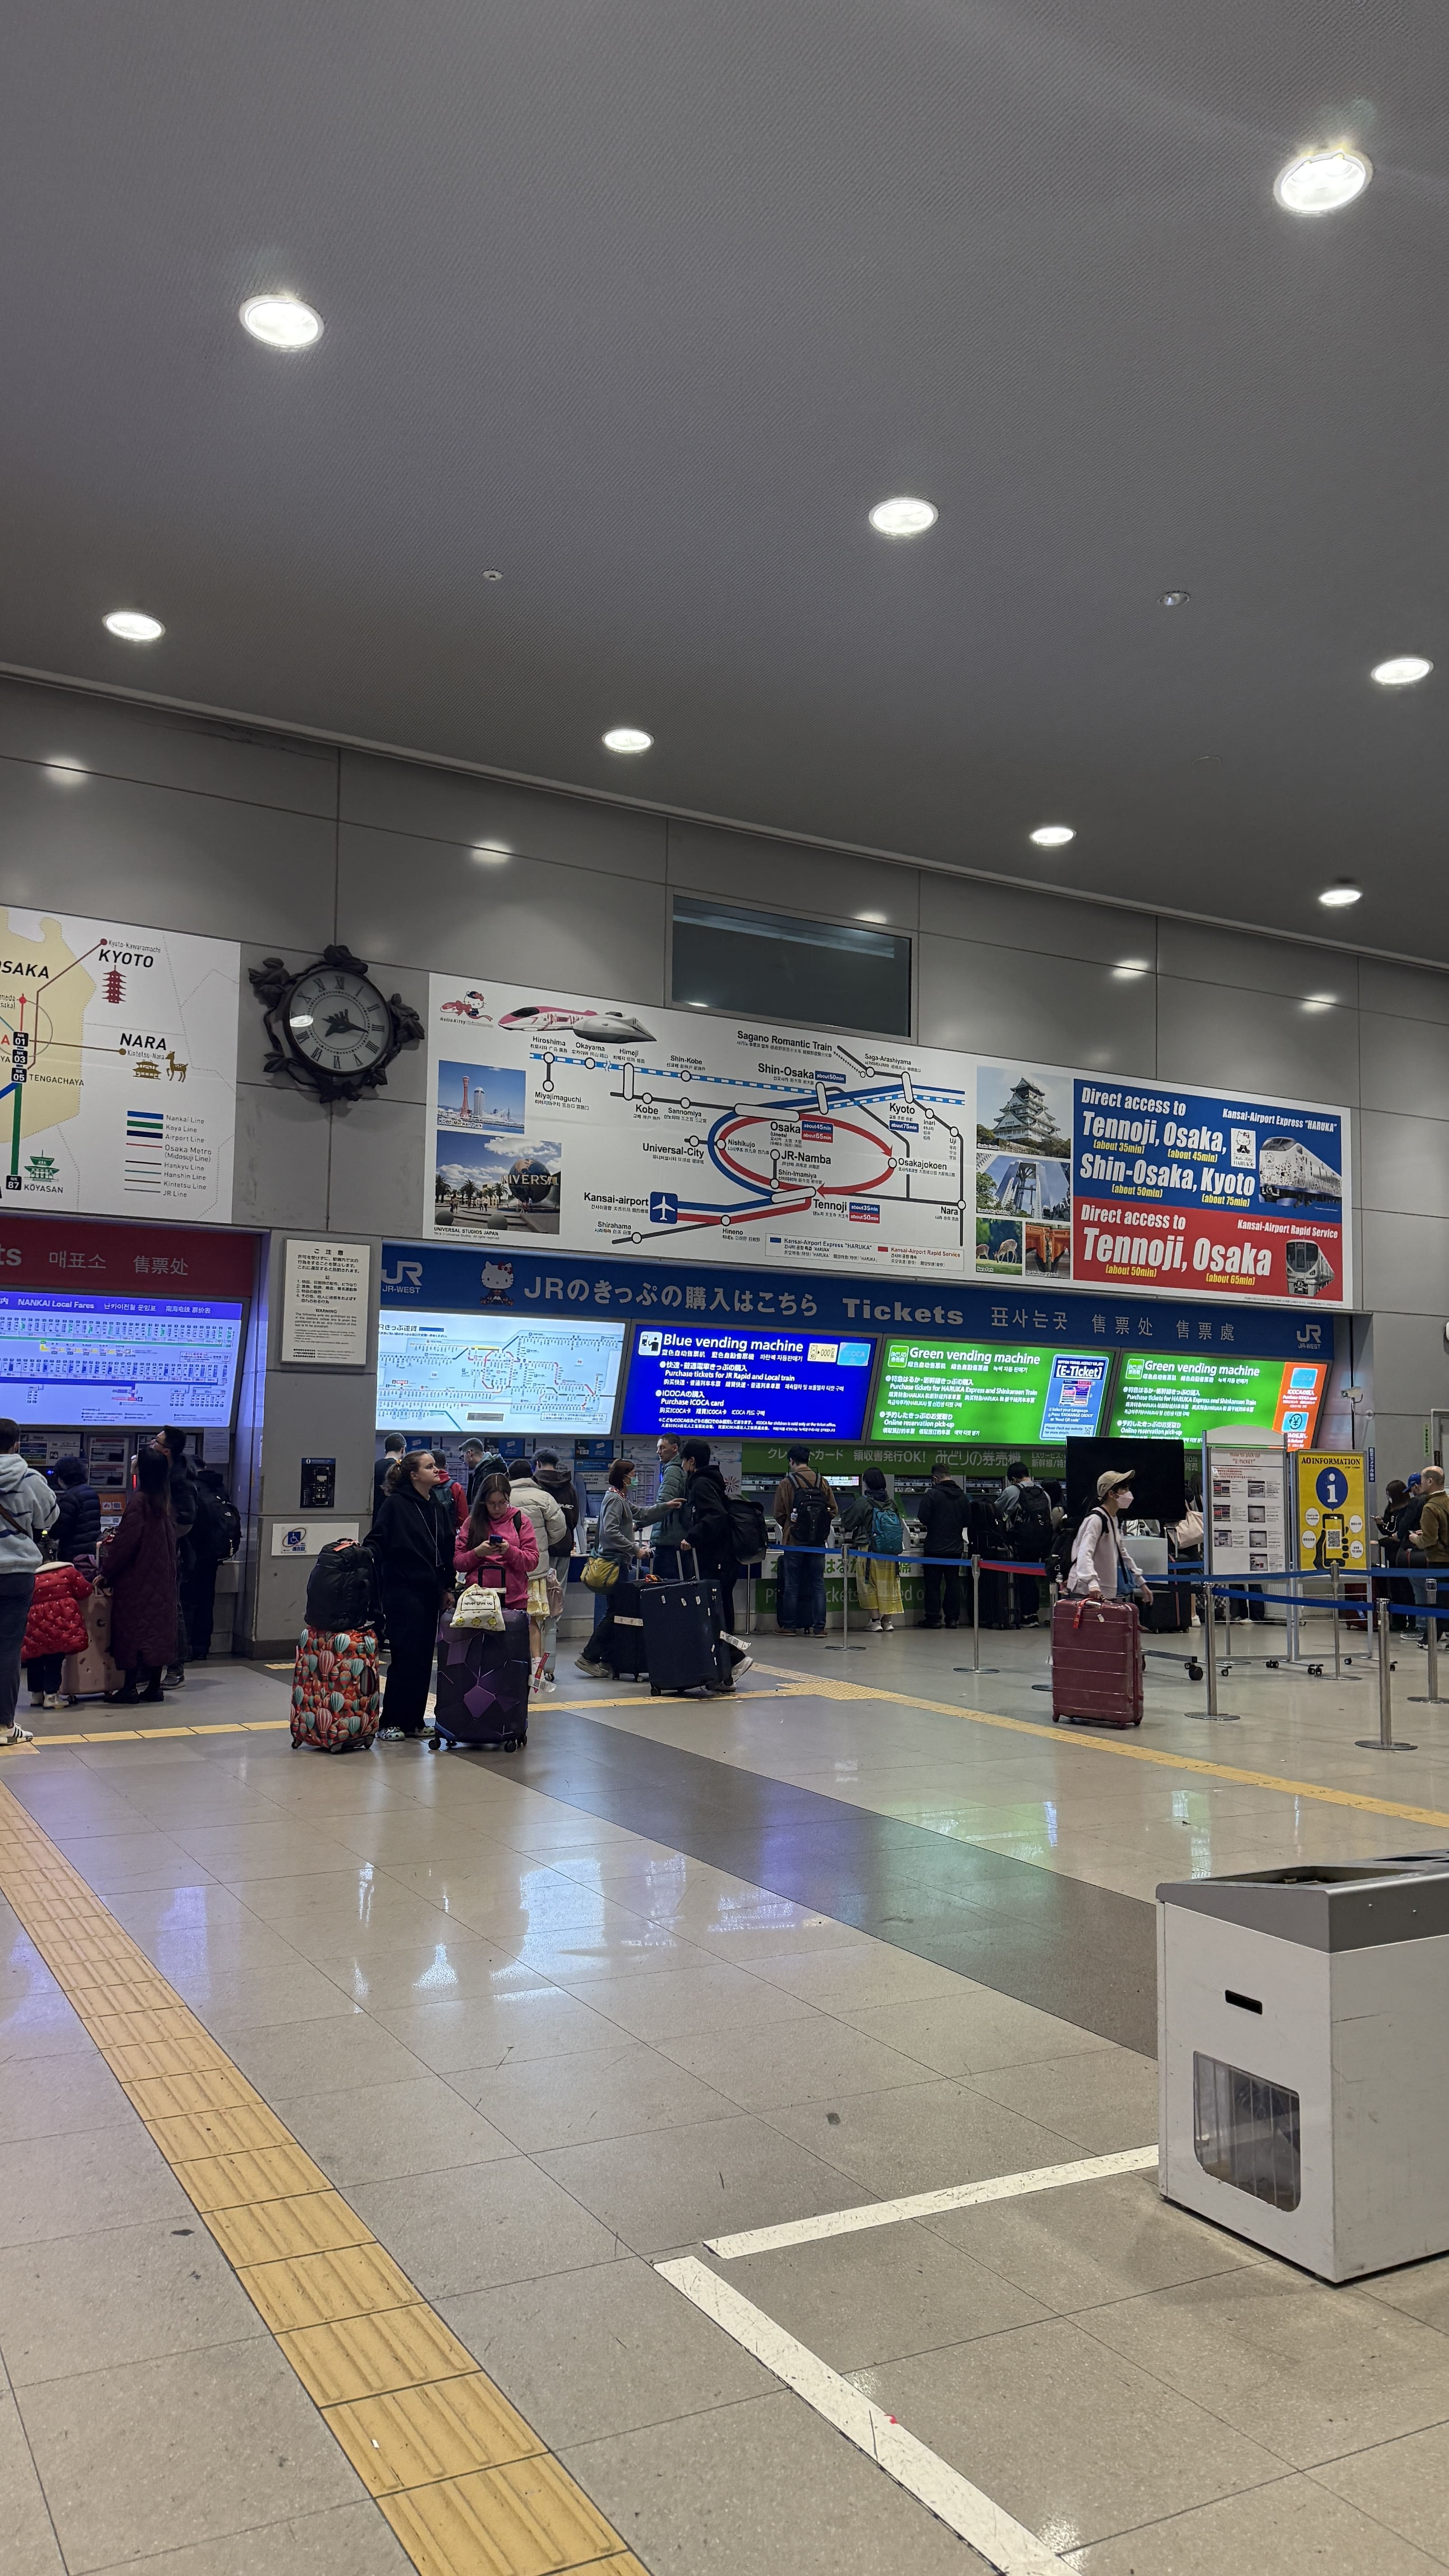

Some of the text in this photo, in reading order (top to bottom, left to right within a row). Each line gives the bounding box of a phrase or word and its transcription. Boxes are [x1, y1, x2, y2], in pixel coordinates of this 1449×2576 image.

[99, 949, 153, 968] KYOTO
[0, 960, 49, 979] SAKA
[120, 1033, 166, 1050] NARA
[533, 1036, 566, 1046] Hiroshima
[575, 1042, 605, 1052] Okayama
[737, 1030, 769, 1043] Sagano
[772, 1035, 810, 1048] Romantic
[813, 1041, 832, 1052] Train
[128, 1050, 165, 1060] Kintetsu-Nara
[619, 1048, 639, 1057] Himeji
[671, 1055, 702, 1064] Shin-Kobe
[865, 1053, 911, 1065] Saga-Arashiyama
[758, 1063, 814, 1079] Shin-Osaka
[29, 1074, 84, 1086] TENGACHAYA
[535, 1091, 581, 1103] Miyajimaguchi
[1081, 1087, 1186, 1116] Direct access to
[636, 1104, 658, 1114] Kobe
[668, 1108, 702, 1117] Sannomiya
[889, 1103, 915, 1116] Kyoto
[1223, 1109, 1275, 1124] Kansai-Airport
[1276, 1116, 1303, 1127] Express
[770, 1122, 800, 1133] Osaka
[1082, 1111, 1227, 1155] Tennoji, Osaka,
[728, 1139, 755, 1148] Nishikujo
[165, 1152, 193, 1161] (Midosuji
[643, 1143, 704, 1159] Universal-City
[781, 1150, 831, 1164] JR-Namba
[898, 1158, 947, 1170] Osakajokoen
[500, 1174, 559, 1186] UNIVERSAL
[778, 1169, 817, 1179] Shin-Imamiya
[1080, 1153, 1256, 1196] Shin-Osaka, Kyoto
[8, 1181, 19, 1189] 87
[584, 1192, 649, 1206] Kansai-airport
[813, 1199, 847, 1213] Tennoji
[941, 1206, 958, 1215] Nara
[1081, 1204, 1186, 1230] Direct access to
[598, 1221, 631, 1229] Shirahama
[1237, 1219, 1338, 1239] Kansai-Airport Rapid Service
[784, 1238, 822, 1247] Kansai-Airport
[891, 1247, 926, 1255] Kansai-Airport
[1083, 1227, 1272, 1276] Tennoji, Osaka
[49, 1251, 106, 1269] 매표소
[133, 1255, 189, 1275] 售票处
[382, 1260, 423, 1286] JR
[18, 1298, 94, 1309] NANKAI Local Fares
[524, 1276, 818, 1317] JRのきっぷの購入はこちら
[842, 1297, 964, 1325] Tickets
[1091, 1314, 1153, 1336] 售票处
[1176, 1320, 1235, 1341] 售票處
[1296, 1324, 1322, 1343] JR
[663, 1334, 803, 1352] Blue vending machine
[910, 1348, 1040, 1365] Green vending machine
[1145, 1361, 1260, 1376] Green vending machine
[733, 1372, 750, 1380] Rapid
[768, 1447, 843, 1460] クレトカード
